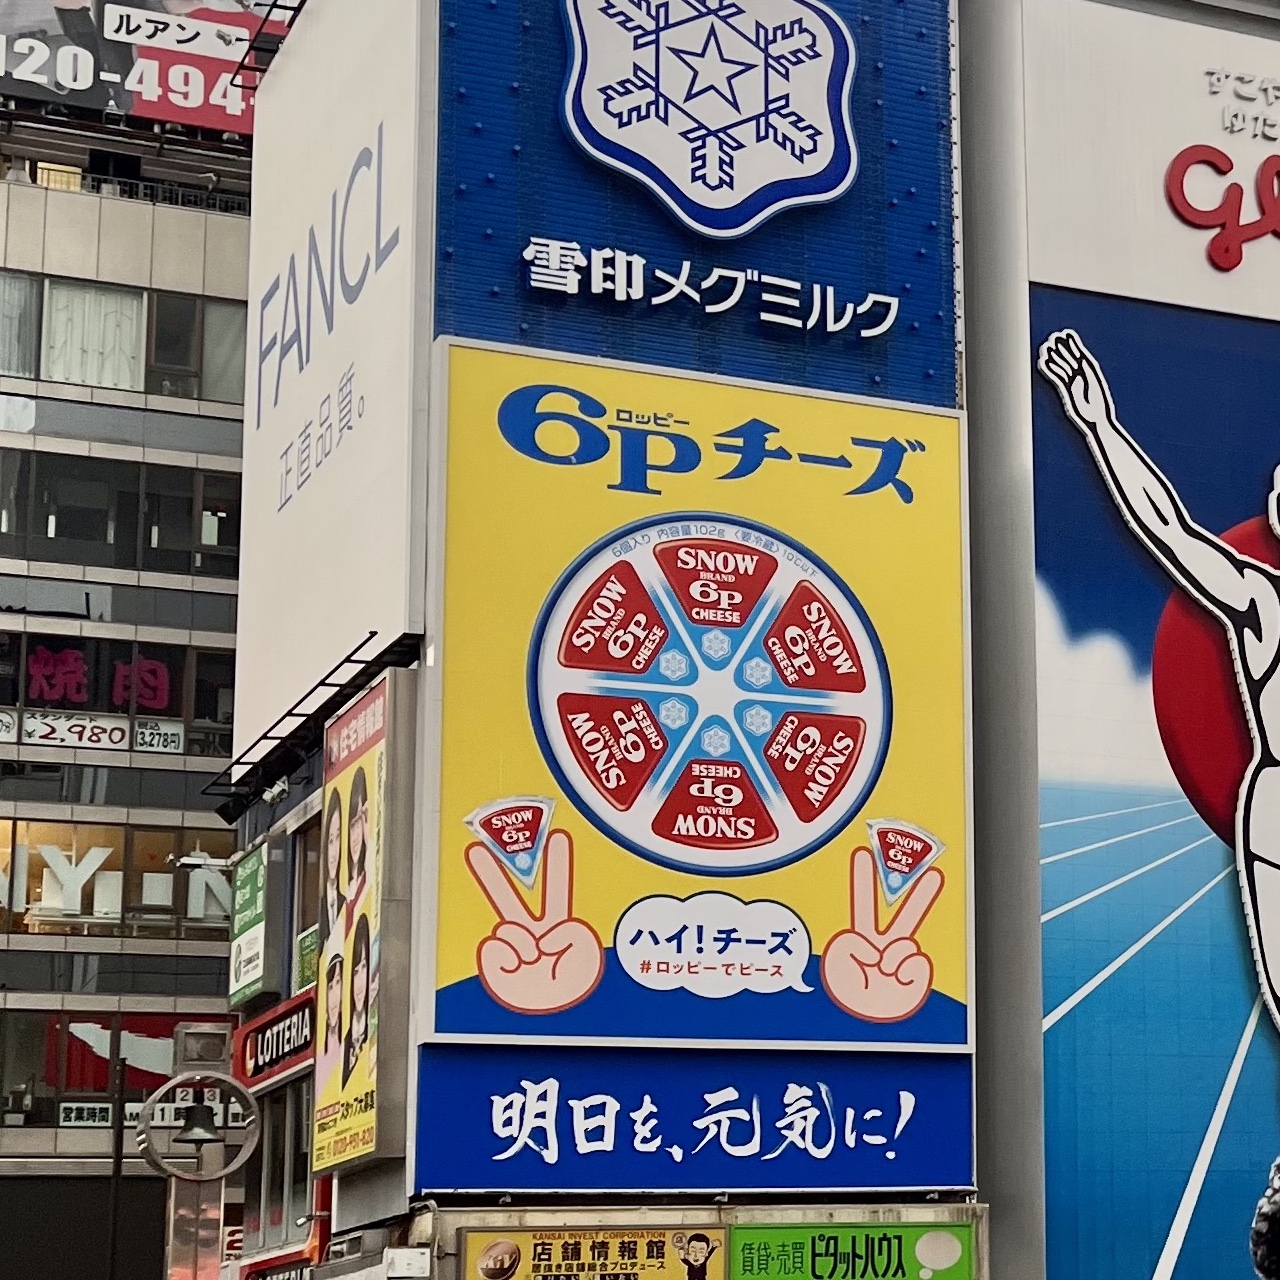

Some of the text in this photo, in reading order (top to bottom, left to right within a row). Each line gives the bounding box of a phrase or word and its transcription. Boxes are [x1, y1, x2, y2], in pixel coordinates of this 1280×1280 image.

[112, 13, 201, 45] ルアン
[0, 35, 255, 116] 20-494
[256, 120, 400, 431] FANCL
[522, 236, 900, 338] 雪印メグミルク
[615, 408, 690, 428] ロッピー
[277, 361, 366, 513] 正直品質。
[611, 533, 652, 559] 6個入り
[676, 546, 760, 576] SNOW
[699, 570, 736, 582] BRAND
[688, 580, 743, 610] 6P
[571, 574, 628, 654] SNOW
[601, 607, 626, 641] BRAND
[691, 607, 741, 624] CHEESE
[607, 612, 650, 659] 6P
[631, 624, 666, 670] CHEESE
[784, 625, 816, 677] 6P
[801, 601, 858, 675] SNOW
[804, 628, 828, 662] BRAND
[767, 637, 799, 685] CHEESE
[599, 724, 625, 761] BRAND
[611, 710, 647, 764] 6P
[630, 701, 664, 751] CHEESE
[767, 715, 799, 760] CHEESE
[566, 711, 628, 791] SNOW
[783, 725, 823, 772] 6P
[804, 743, 828, 776] BRAND
[691, 763, 742, 779] CHEESE
[803, 730, 855, 809] SNOW
[688, 777, 744, 807] 6P
[490, 808, 534, 829] SNOW
[671, 813, 756, 840] SNOW
[696, 805, 733, 816] BRAND
[885, 831, 925, 853] SNOW
[639, 959, 785, 978] #ロッピーでピース
[257, 1007, 311, 1067] LOTTERIA
[62, 1106, 110, 1124] 営業時間
[531, 1231, 666, 1240] KANSAI INVEST CORPORATION
[531, 1239, 666, 1263] 店舗情報館
[810, 1232, 907, 1280] ピタットハウス
